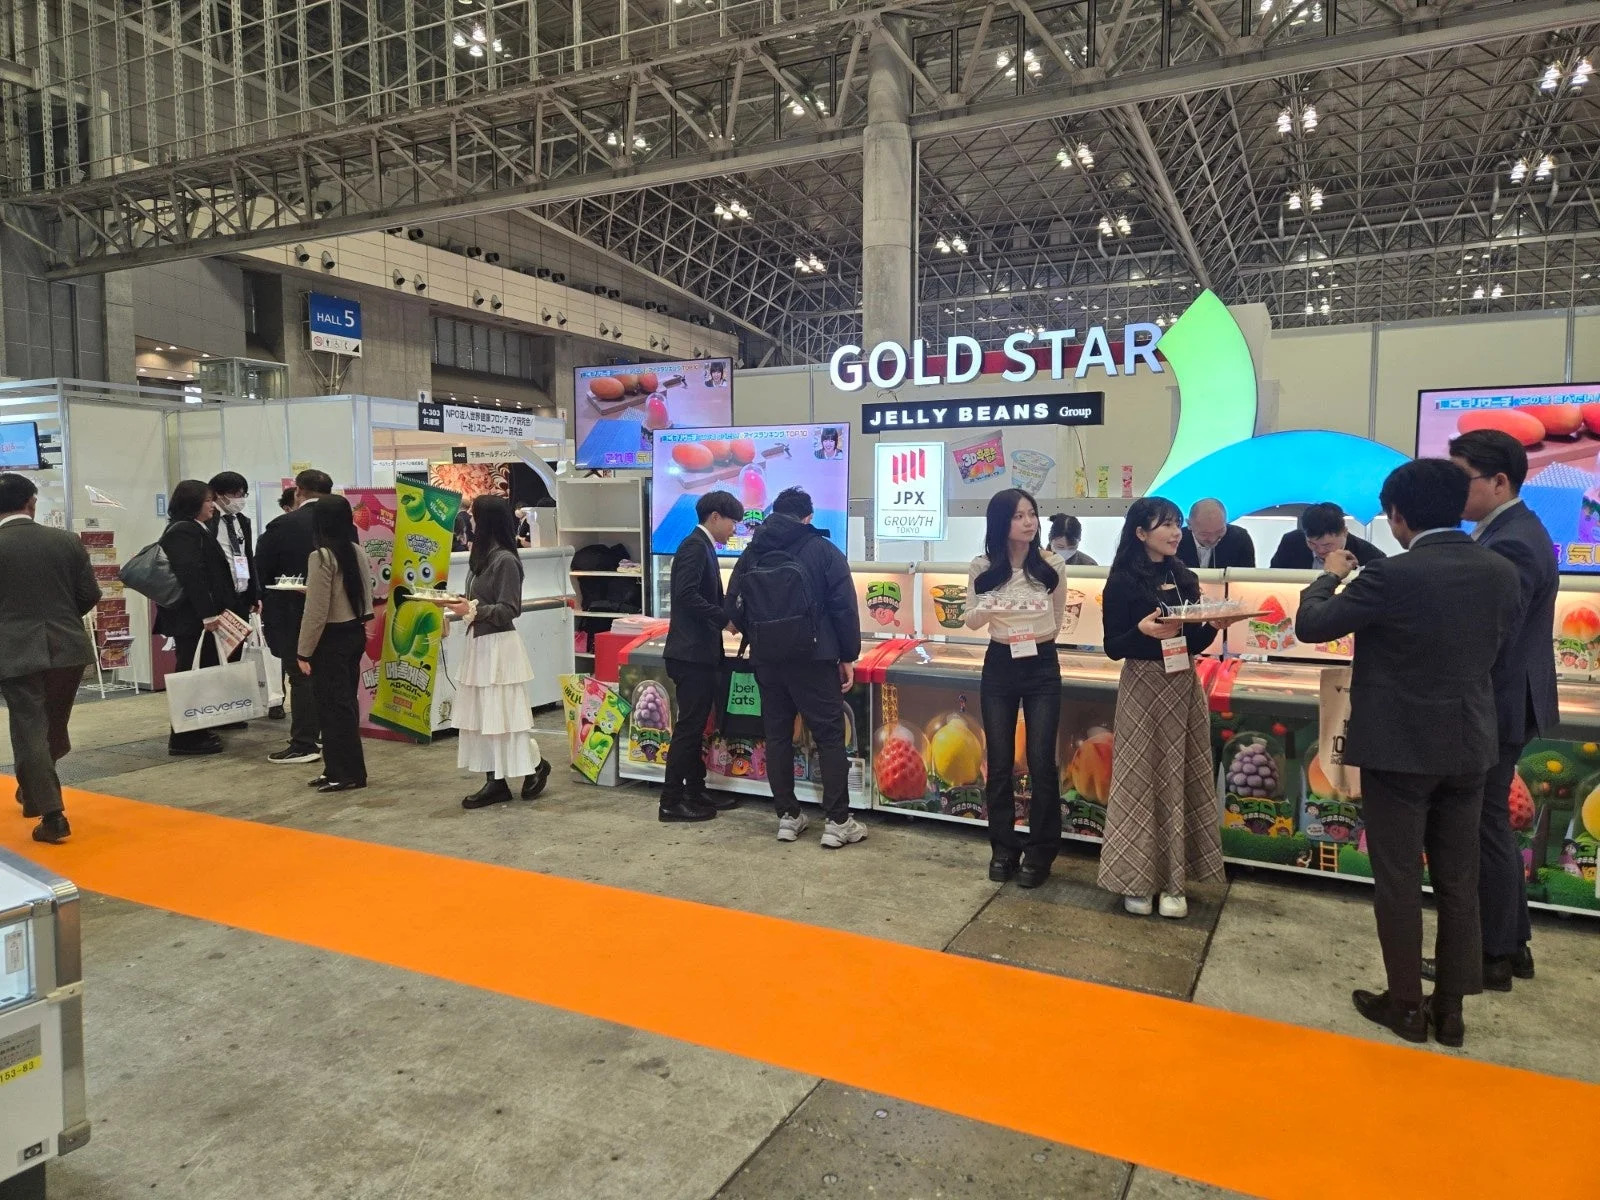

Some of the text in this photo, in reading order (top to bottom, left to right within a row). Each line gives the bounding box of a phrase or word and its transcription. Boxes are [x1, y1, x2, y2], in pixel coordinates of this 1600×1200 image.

[316, 309, 355, 328] HALL 5
[830, 322, 1164, 391] GOLD STAR
[421, 408, 441, 417] 4-303
[869, 402, 1092, 426] JELLY BEANS Group
[422, 417, 440, 426] 兵庫県
[962, 452, 978, 467] 3D
[893, 491, 925, 505] JPX
[884, 515, 934, 527] GROWTH
[896, 526, 920, 534] TOKYO
[866, 581, 902, 602] 3D
[732, 682, 756, 693] ber
